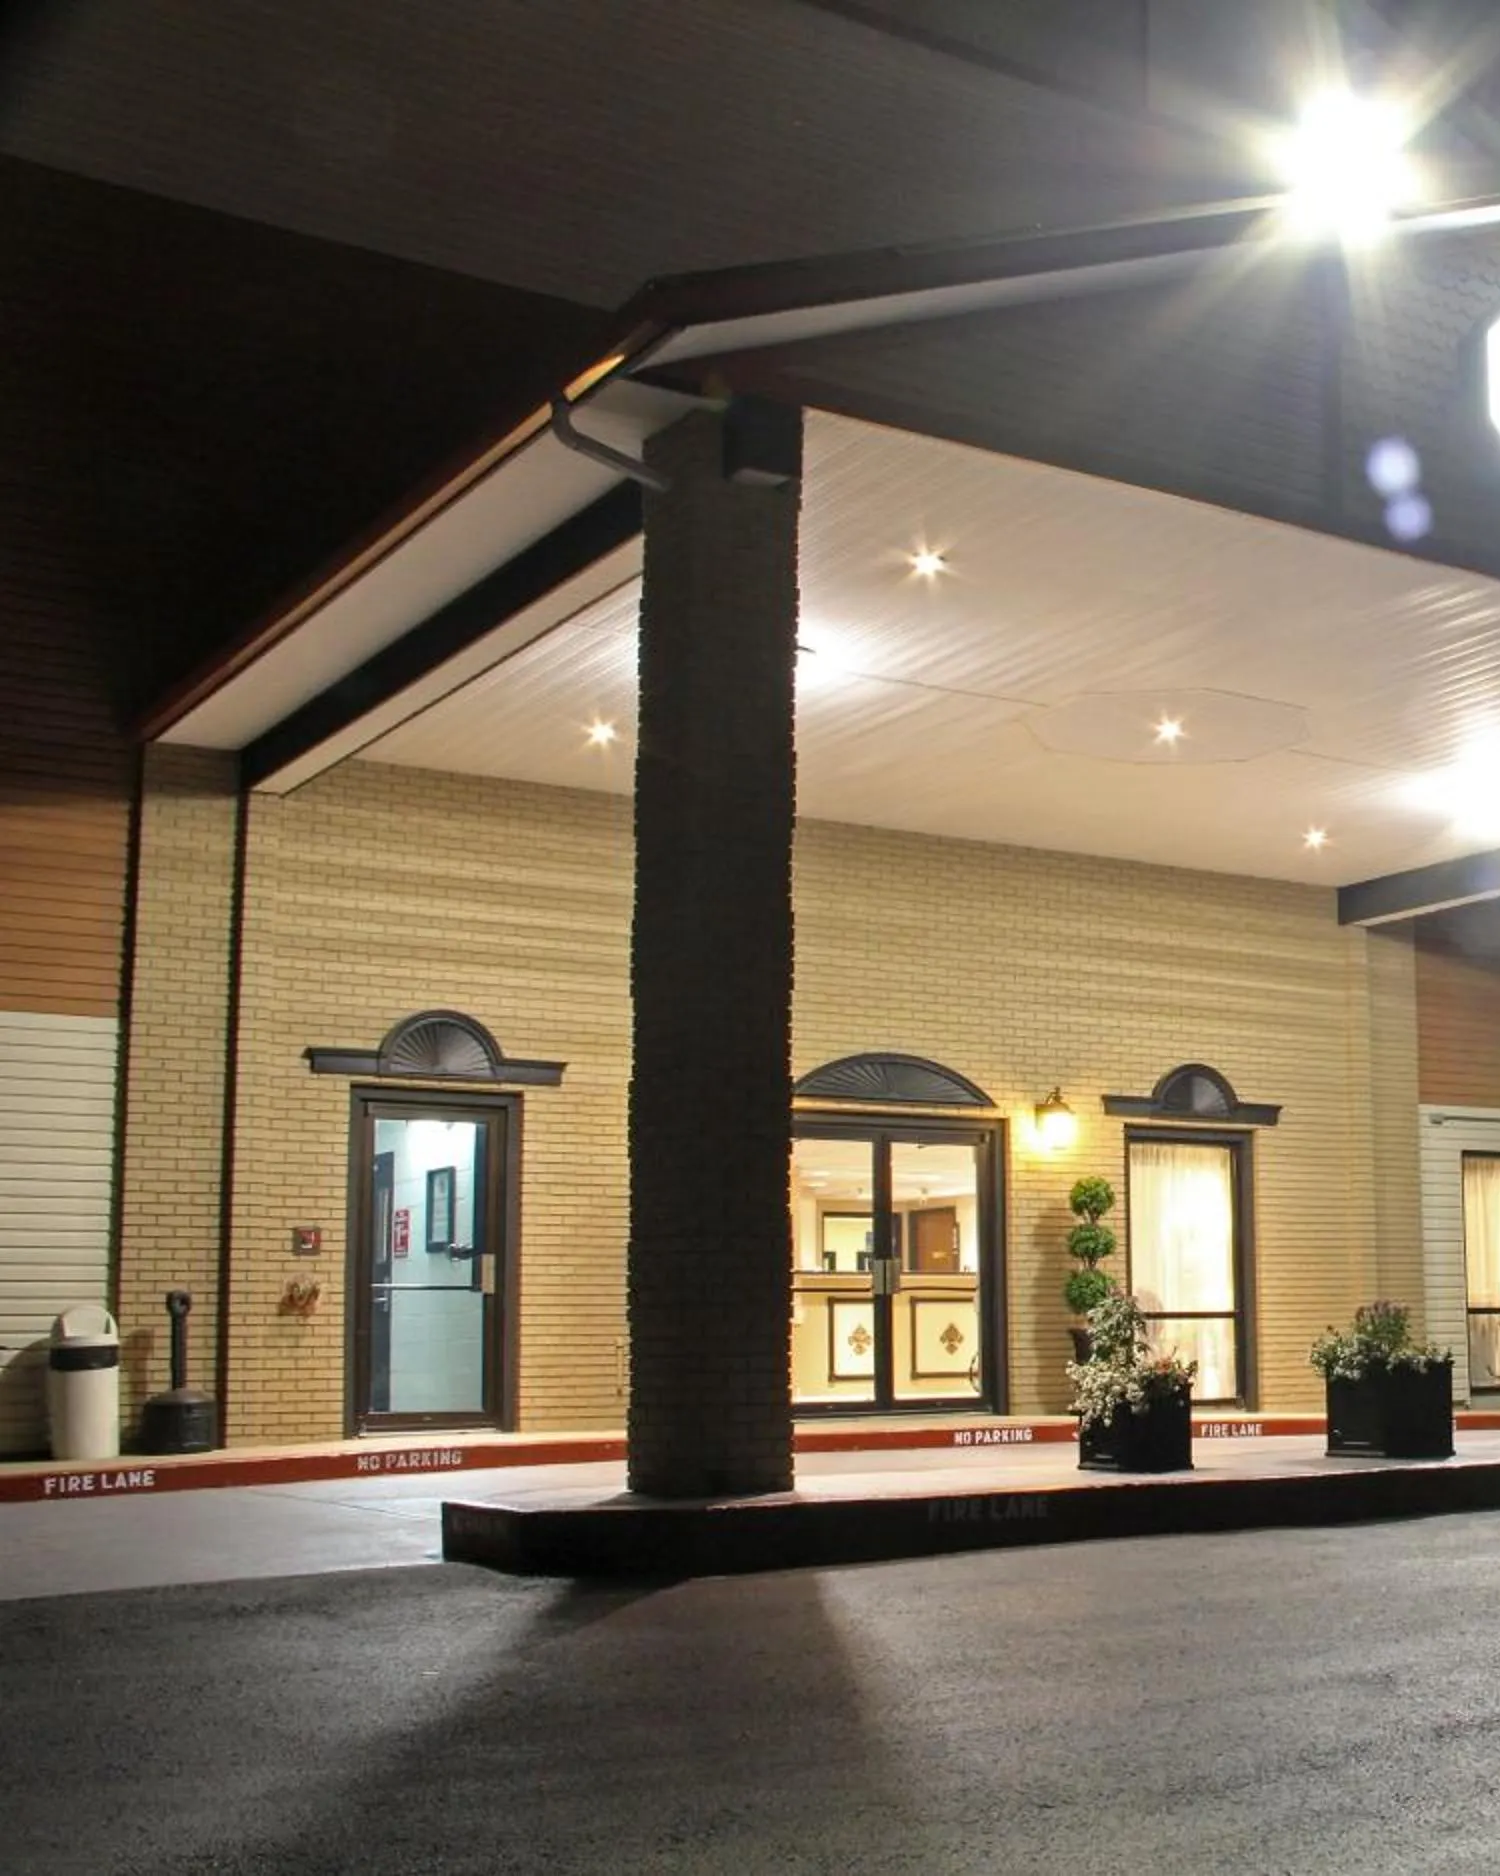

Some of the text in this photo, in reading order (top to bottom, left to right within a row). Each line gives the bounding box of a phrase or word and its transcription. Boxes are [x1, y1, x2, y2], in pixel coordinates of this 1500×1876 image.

[954, 1428, 1032, 1444] NO PARKING
[1201, 1424, 1263, 1437] FIRE LANE
[357, 1450, 462, 1470] NO PARKING
[44, 1470, 155, 1494] FIRE LANE
